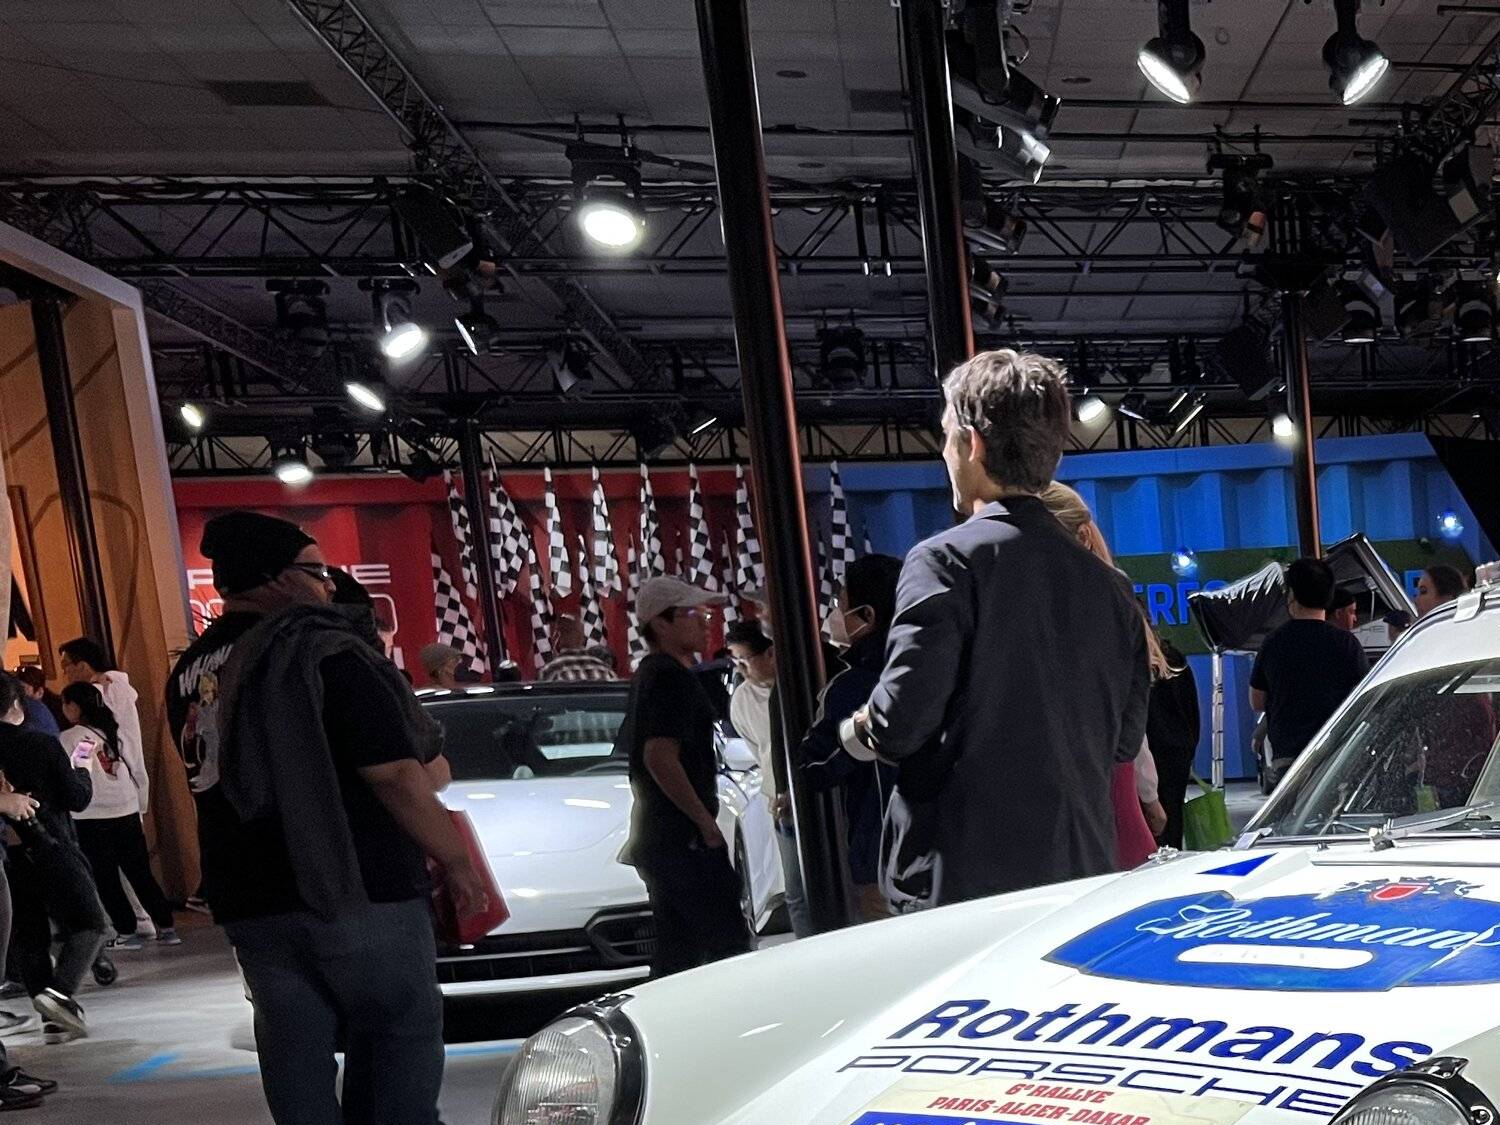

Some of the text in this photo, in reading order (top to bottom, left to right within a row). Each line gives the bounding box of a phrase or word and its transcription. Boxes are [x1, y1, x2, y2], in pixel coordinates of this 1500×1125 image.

[886, 998, 1433, 1078] Rothmans
[836, 1055, 1351, 1117] PORSCHE
[1027, 1085, 1115, 1105] RALLYE
